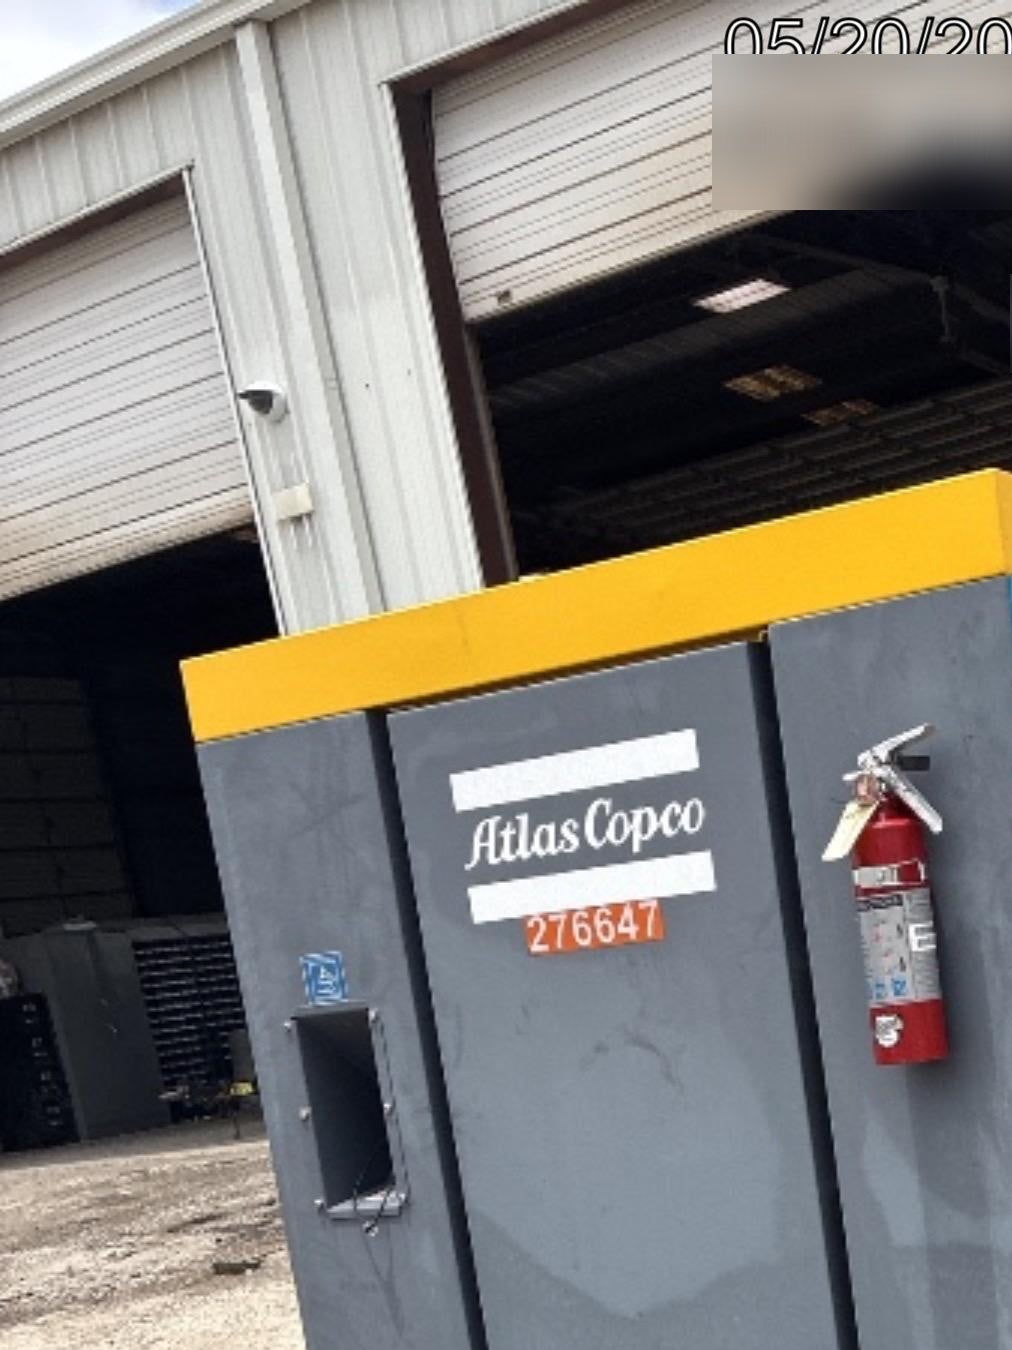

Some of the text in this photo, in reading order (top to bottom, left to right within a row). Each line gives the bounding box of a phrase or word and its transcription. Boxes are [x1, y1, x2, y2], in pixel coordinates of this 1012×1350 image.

[464, 797, 706, 870] Atlas Copco
[526, 901, 658, 953] 276647
